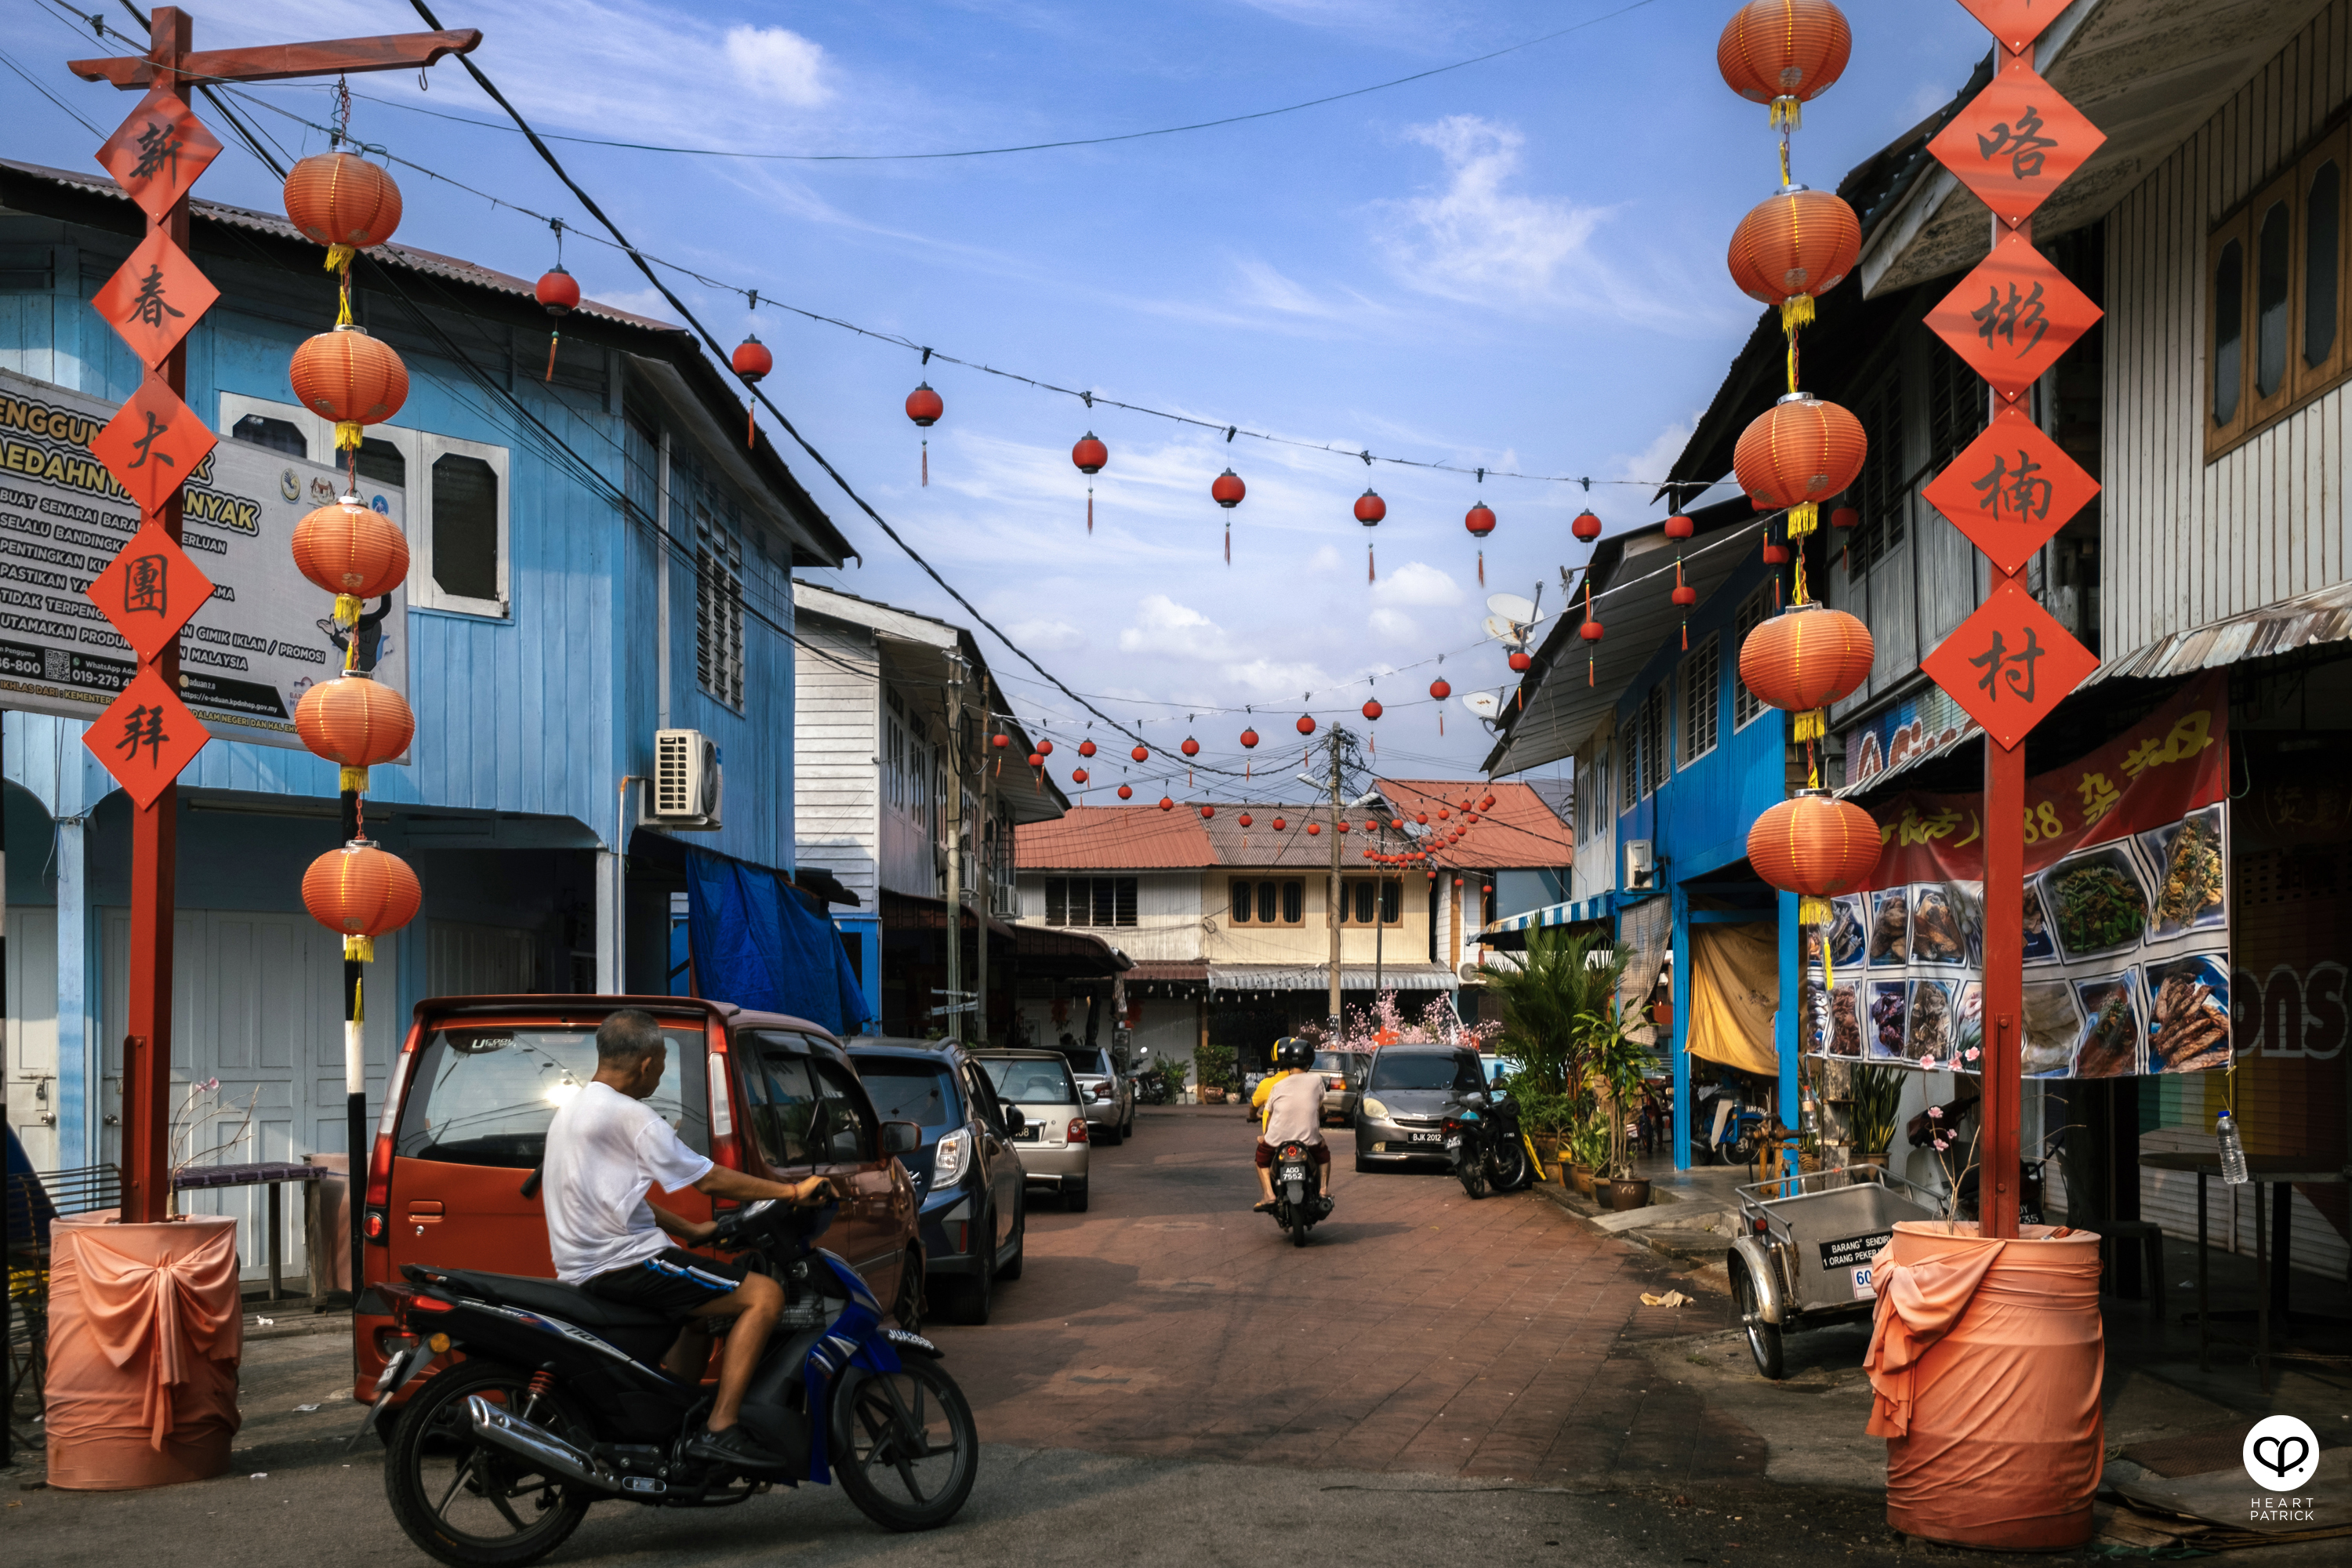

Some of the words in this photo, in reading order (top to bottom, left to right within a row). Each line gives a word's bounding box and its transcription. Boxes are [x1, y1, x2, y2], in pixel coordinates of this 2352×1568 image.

[1, 491, 36, 507] BUAT
[42, 499, 98, 522] SENARAI
[0, 514, 49, 536] SELALU
[1, 539, 84, 568] PENTINGKAN
[1, 564, 66, 587] PASTIKAN
[2, 590, 41, 608] TIDAK
[198, 630, 230, 644] GIMIK
[234, 637, 267, 651] IKLAN
[280, 645, 325, 662] PROMOSI
[1, 615, 75, 639] UTAMAKAN
[191, 650, 249, 670] MALAYSIA
[5, 647, 36, 658] Pengguna
[85, 660, 121, 673] WhatsApp
[72, 669, 120, 687] 019-279
[1, 679, 34, 694] IKHLAS
[36, 685, 58, 697] DARI
[221, 714, 249, 726] NEGERI
[250, 717, 267, 729] DAN
[268, 720, 284, 731] HAL
[1413, 1133, 1426, 1142] BJK
[1426, 1133, 1442, 1142] 2012
[1823, 1258, 1828, 1267] 1
[1829, 1253, 1853, 1265] ORANG
